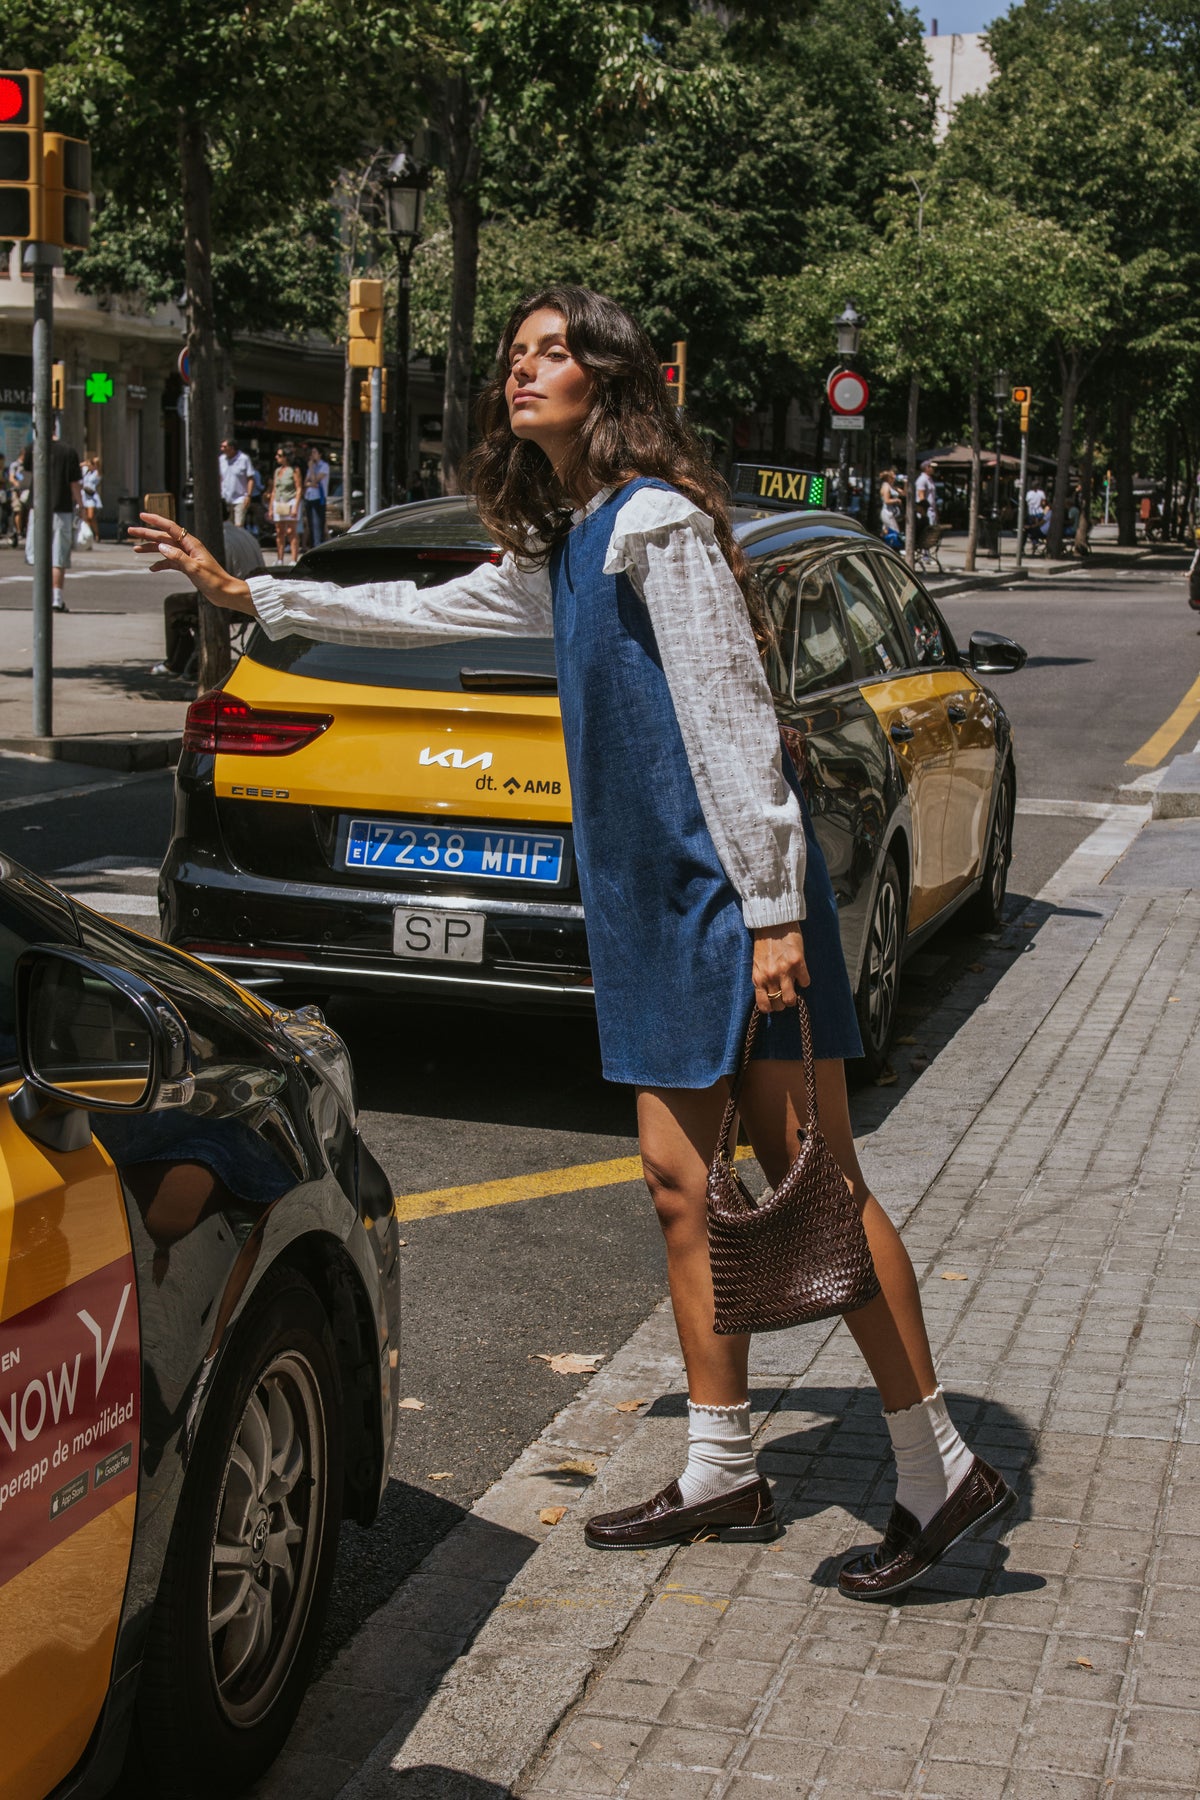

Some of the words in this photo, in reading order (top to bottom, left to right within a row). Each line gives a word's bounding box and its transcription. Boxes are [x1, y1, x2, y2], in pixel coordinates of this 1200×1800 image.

[278, 406, 319, 427] SEPHORA
[758, 469, 807, 500] TAXI
[524, 779, 561, 795] AMB
[353, 848, 362, 859] E
[372, 828, 465, 868] 7238
[481, 837, 553, 875] MHF
[405, 916, 471, 954] SP
[1, 1347, 20, 1373] EN
[52, 1440, 69, 1468] de
[72, 1392, 134, 1455] movilidad
[104, 1460, 121, 1477] Google
[61, 1494, 72, 1507] App
[71, 1485, 84, 1500] Store
